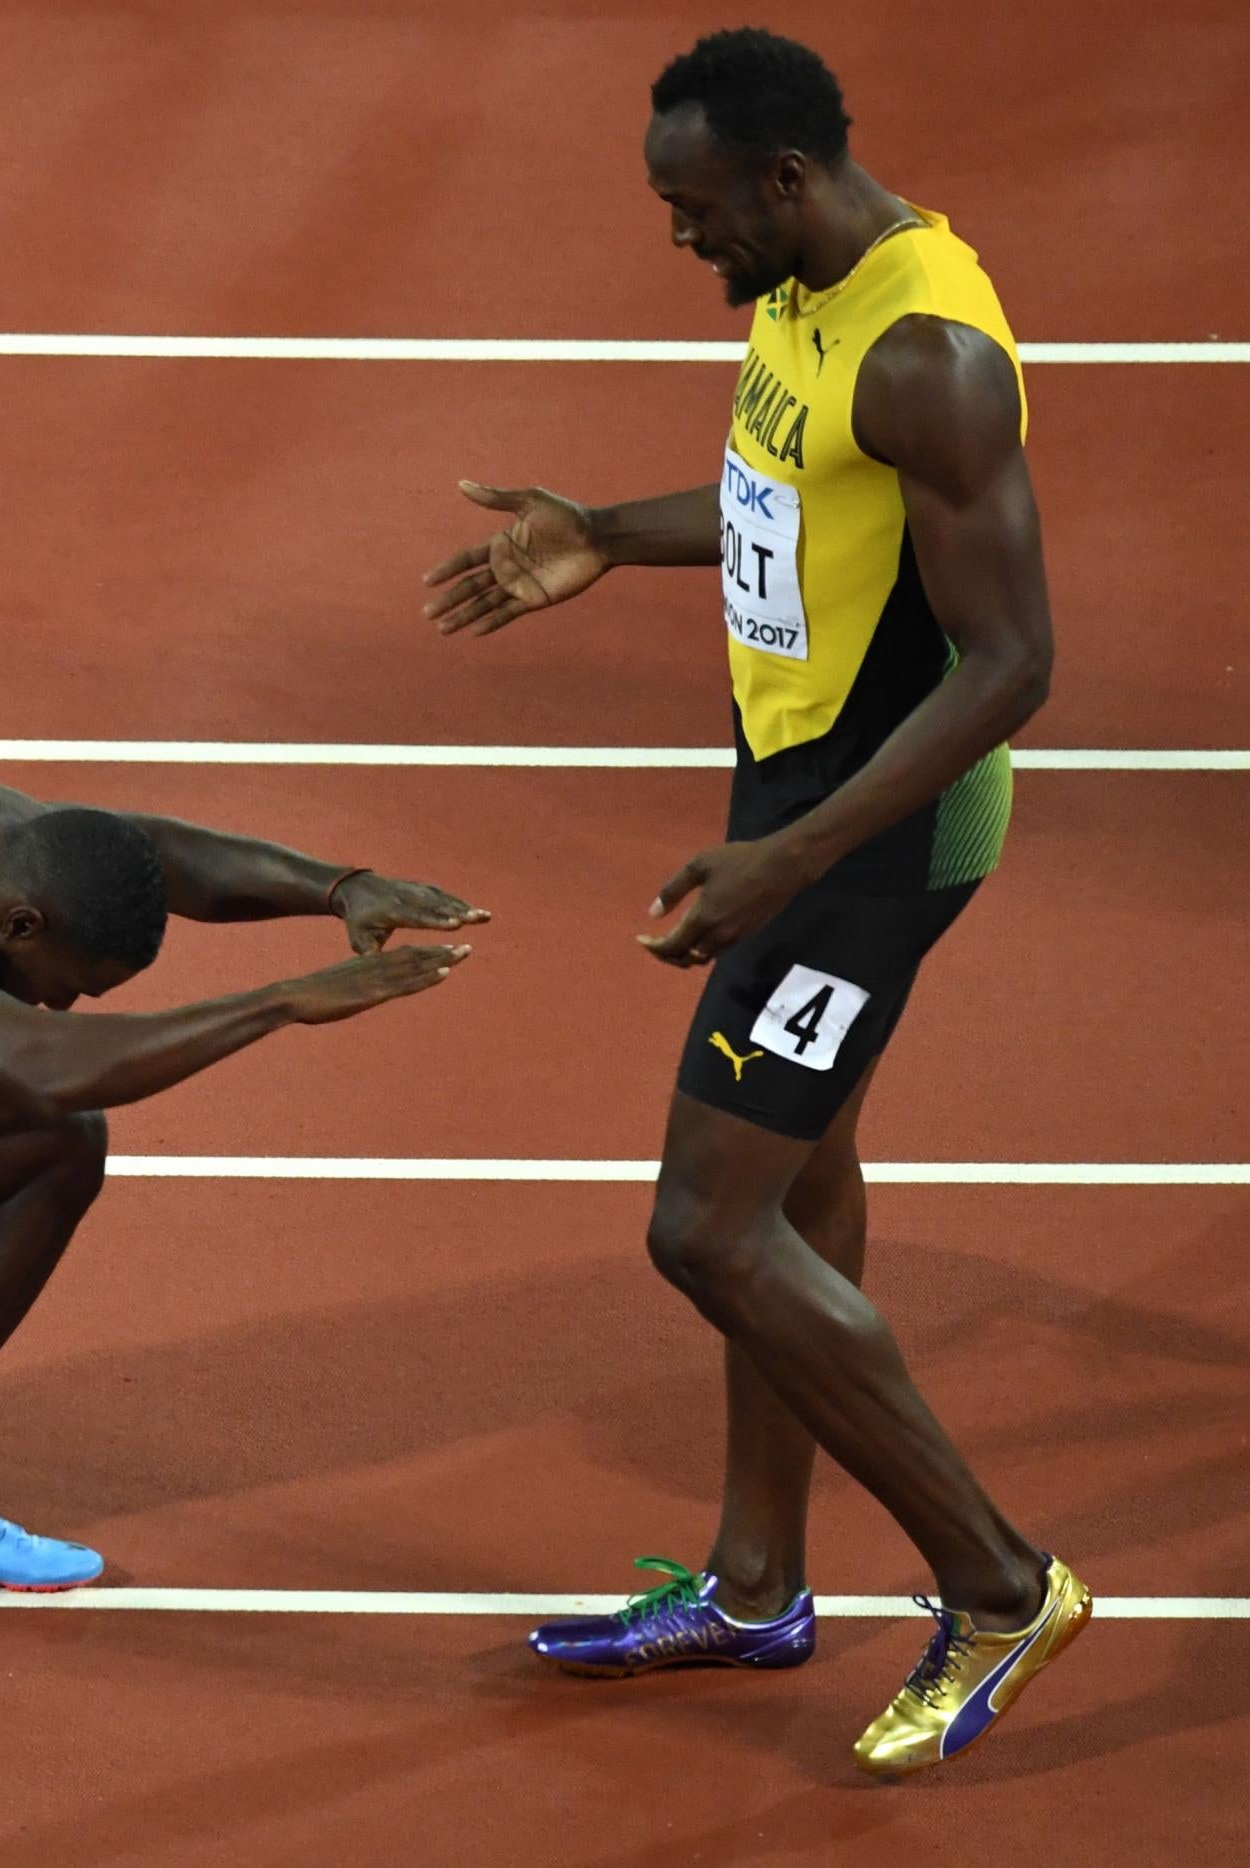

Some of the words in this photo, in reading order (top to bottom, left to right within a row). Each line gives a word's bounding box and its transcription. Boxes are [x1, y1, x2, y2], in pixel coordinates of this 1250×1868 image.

[733, 347, 809, 470] AMAICA
[726, 458, 774, 520] TDK
[746, 618, 799, 649] 2017
[784, 984, 834, 1056] 4
